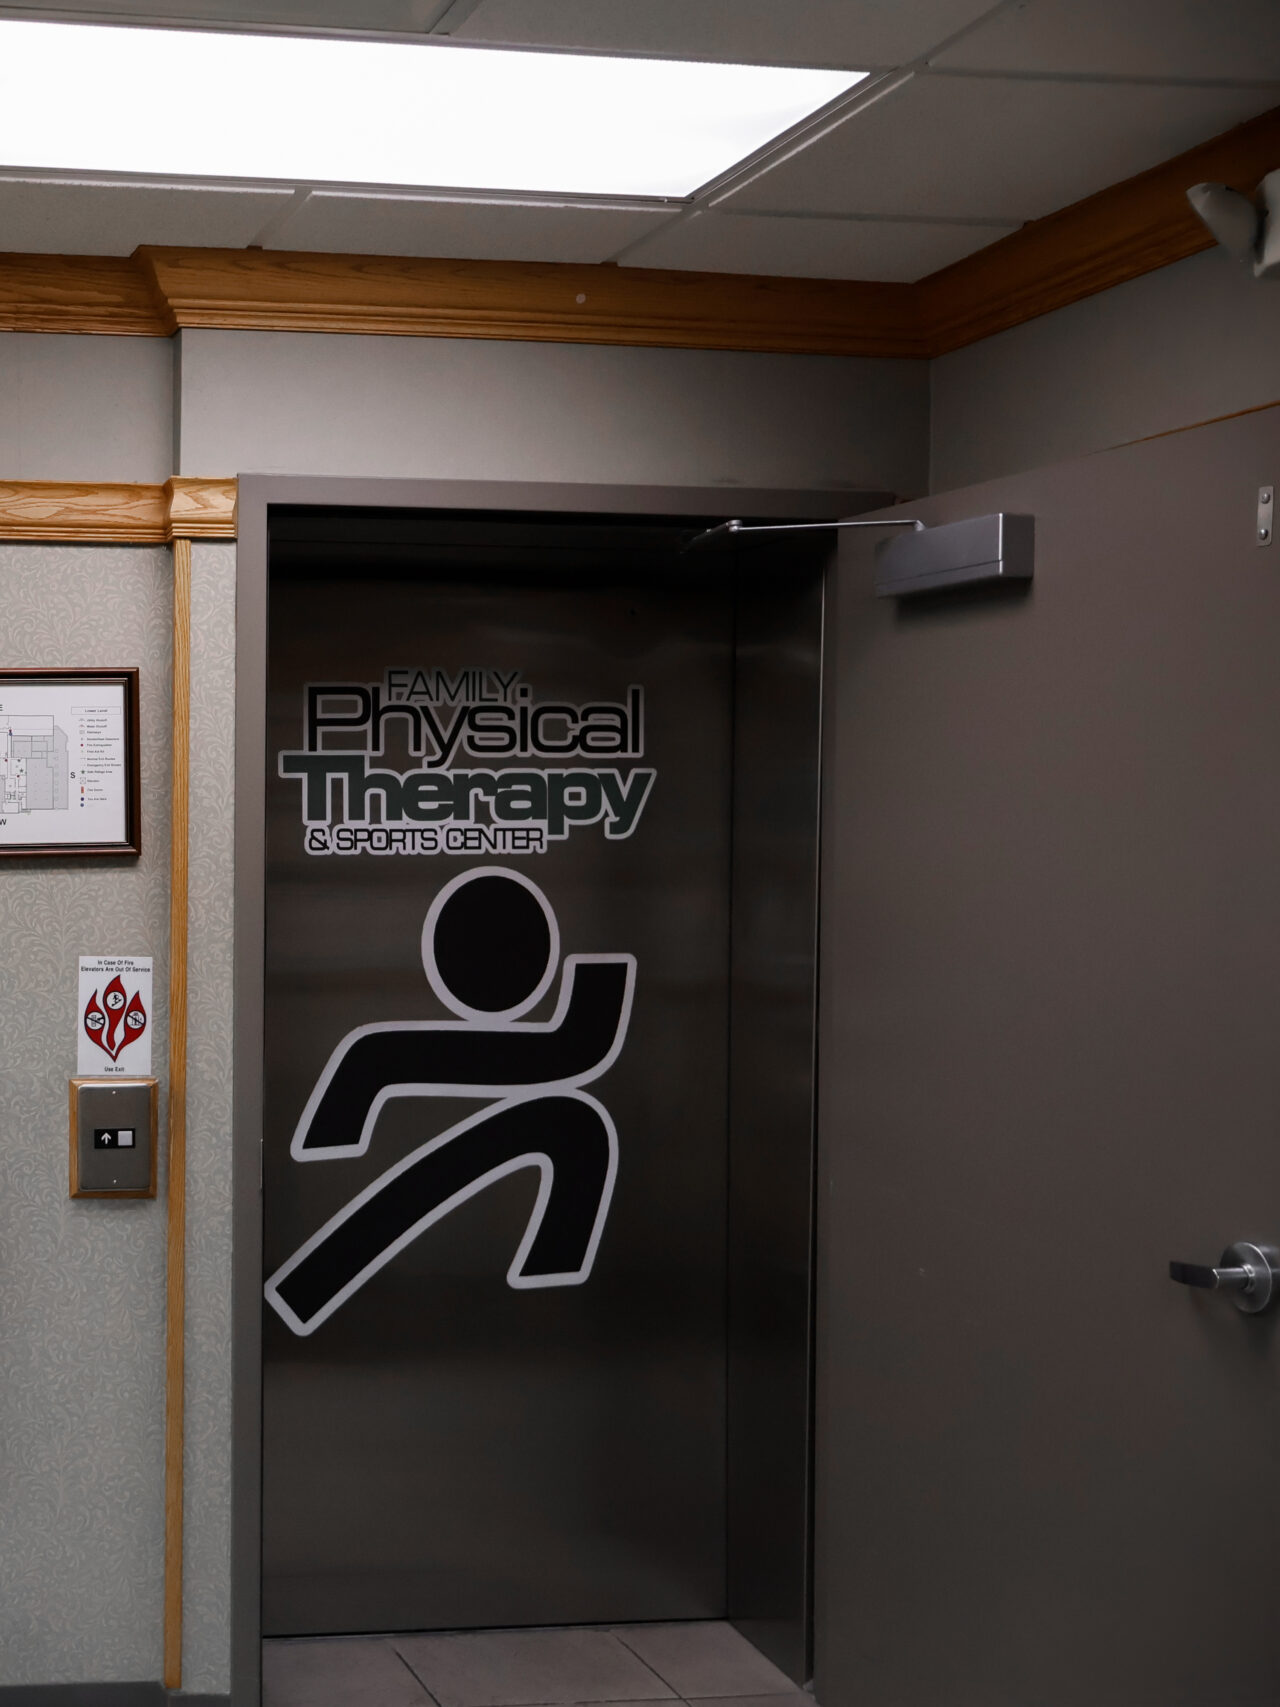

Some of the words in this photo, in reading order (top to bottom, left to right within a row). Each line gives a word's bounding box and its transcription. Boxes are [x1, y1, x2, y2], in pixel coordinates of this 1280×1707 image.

[386, 669, 519, 702] FAMILY
[307, 686, 641, 768] Physical
[282, 754, 654, 835] Therapy
[308, 828, 330, 850] &
[336, 828, 438, 850] SPORTS
[445, 827, 543, 849] CENTER
